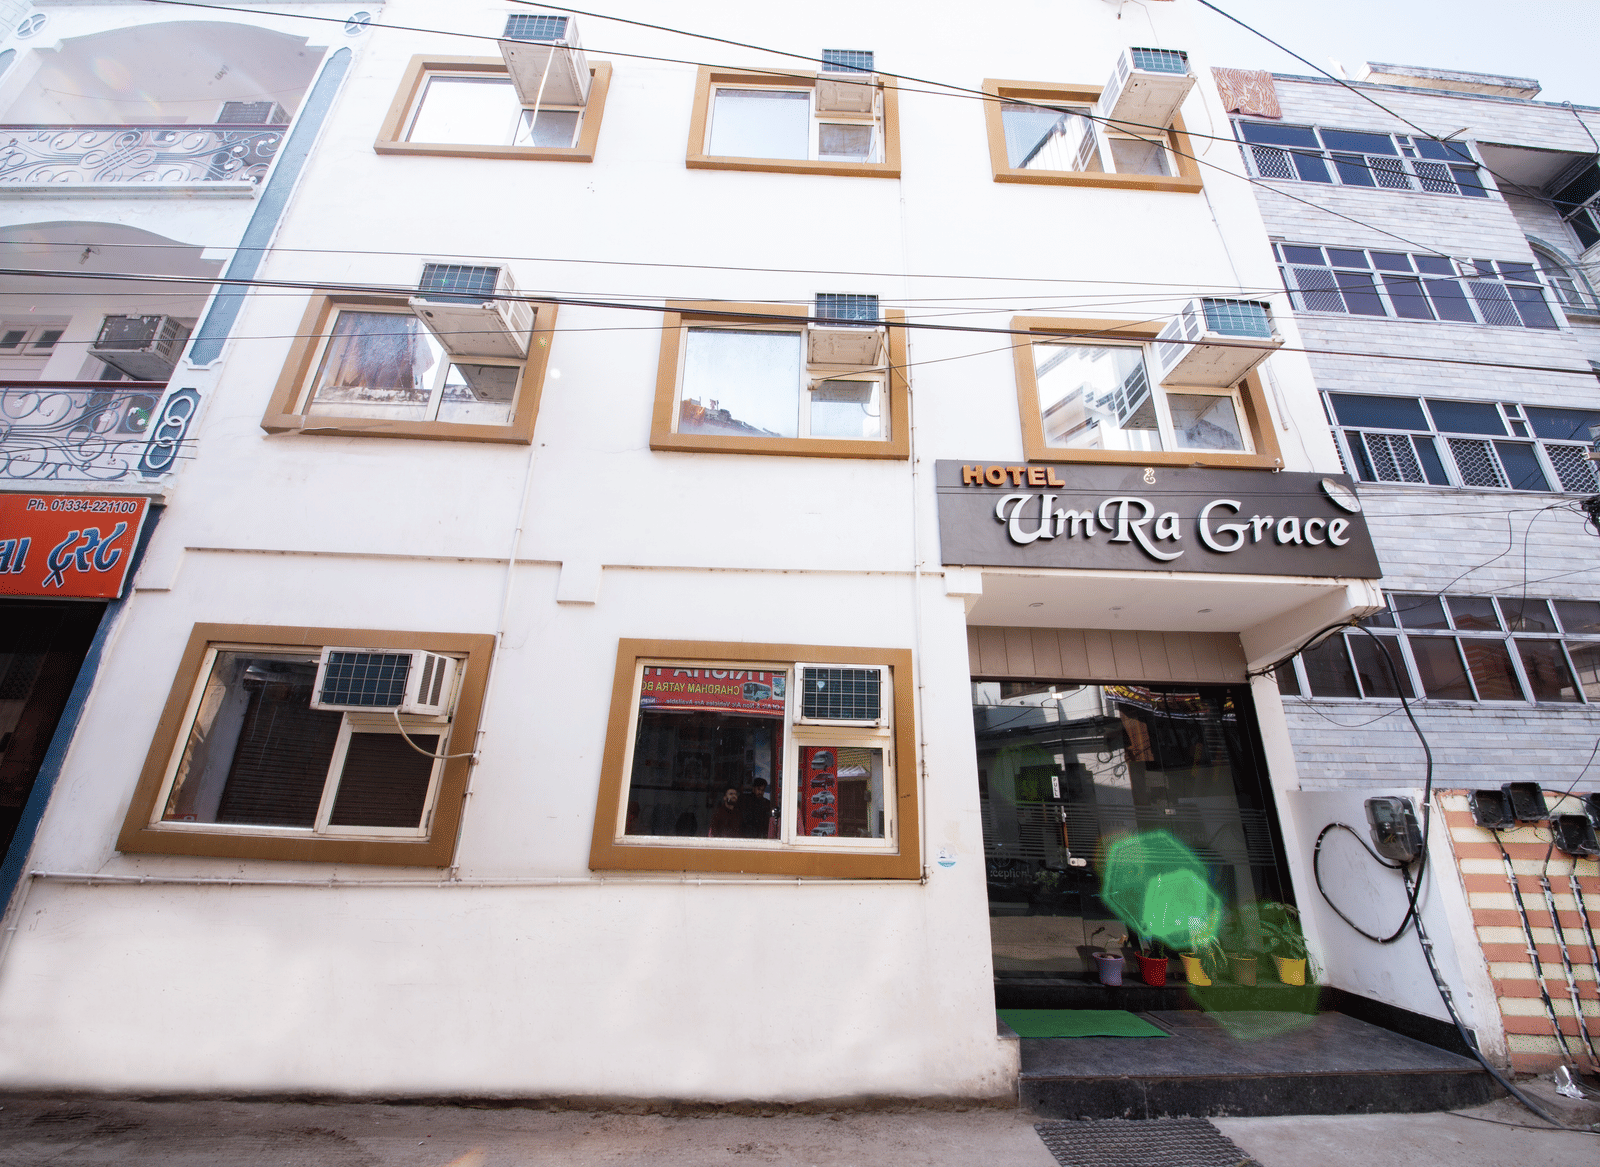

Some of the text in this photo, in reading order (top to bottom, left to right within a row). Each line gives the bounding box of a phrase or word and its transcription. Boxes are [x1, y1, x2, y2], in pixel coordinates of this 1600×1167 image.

[962, 465, 1065, 487] HOTEL
[26, 499, 137, 513] Ph. 01334-221100
[995, 494, 1351, 561] UmRa Grace
